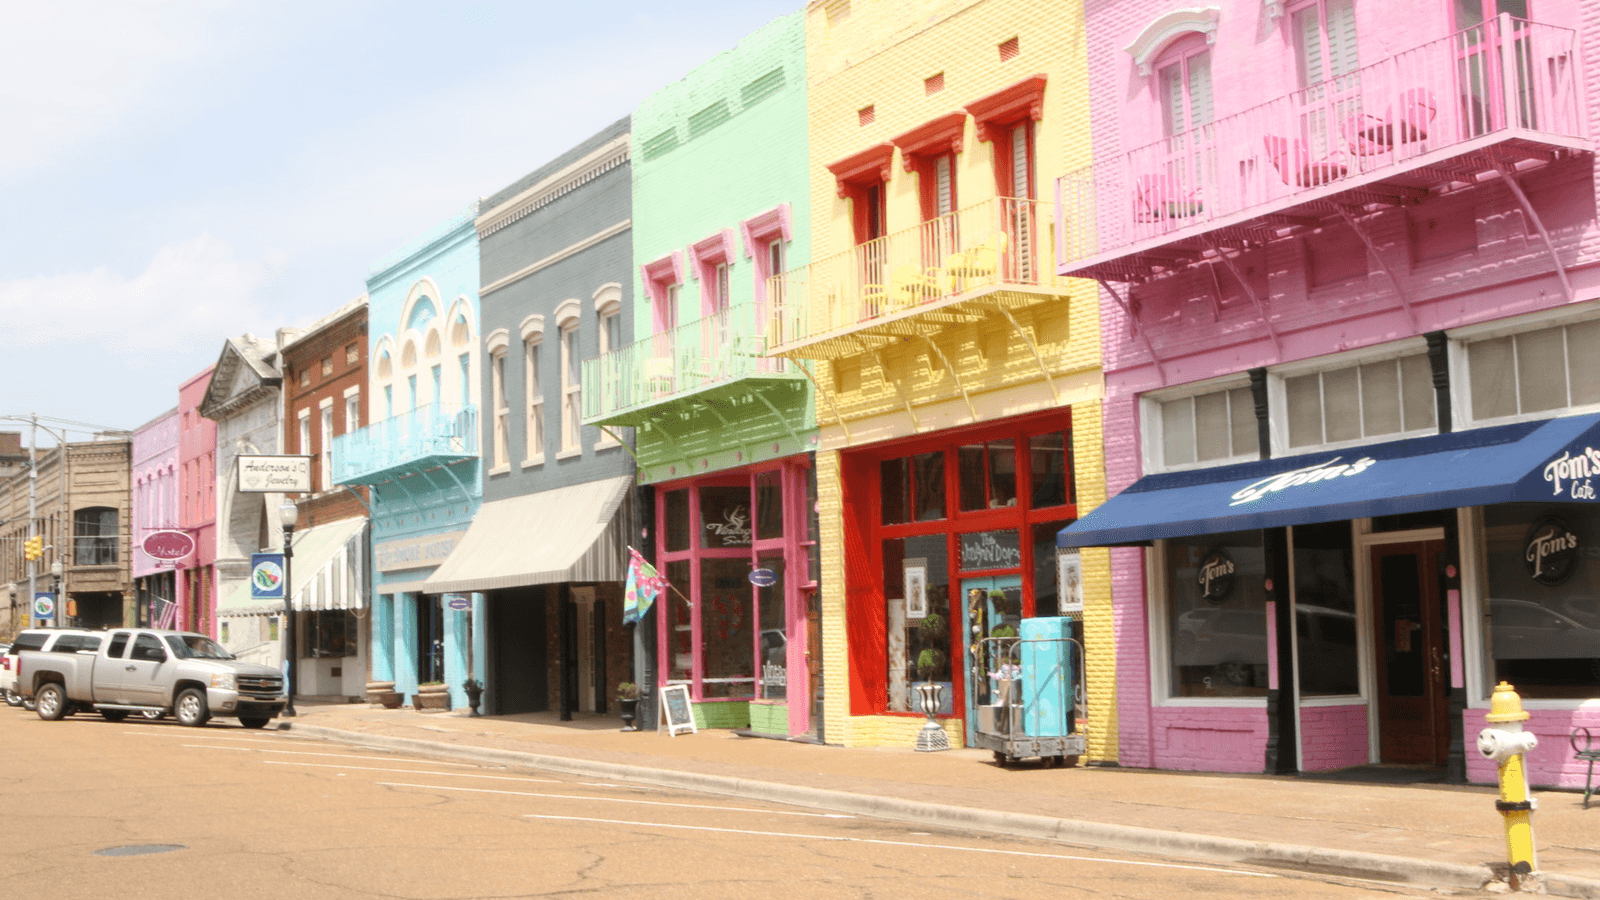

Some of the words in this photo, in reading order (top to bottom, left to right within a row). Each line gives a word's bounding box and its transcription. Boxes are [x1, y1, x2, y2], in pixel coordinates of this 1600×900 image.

[244, 460, 297, 473] Anderson's
[264, 473, 298, 488] Jewelry
[1229, 456, 1377, 506] Tom's
[1544, 446, 1600, 496] Tom's
[705, 522, 752, 542] Vintag
[1526, 529, 1578, 578] Tom's
[1198, 557, 1235, 598] Tom's
